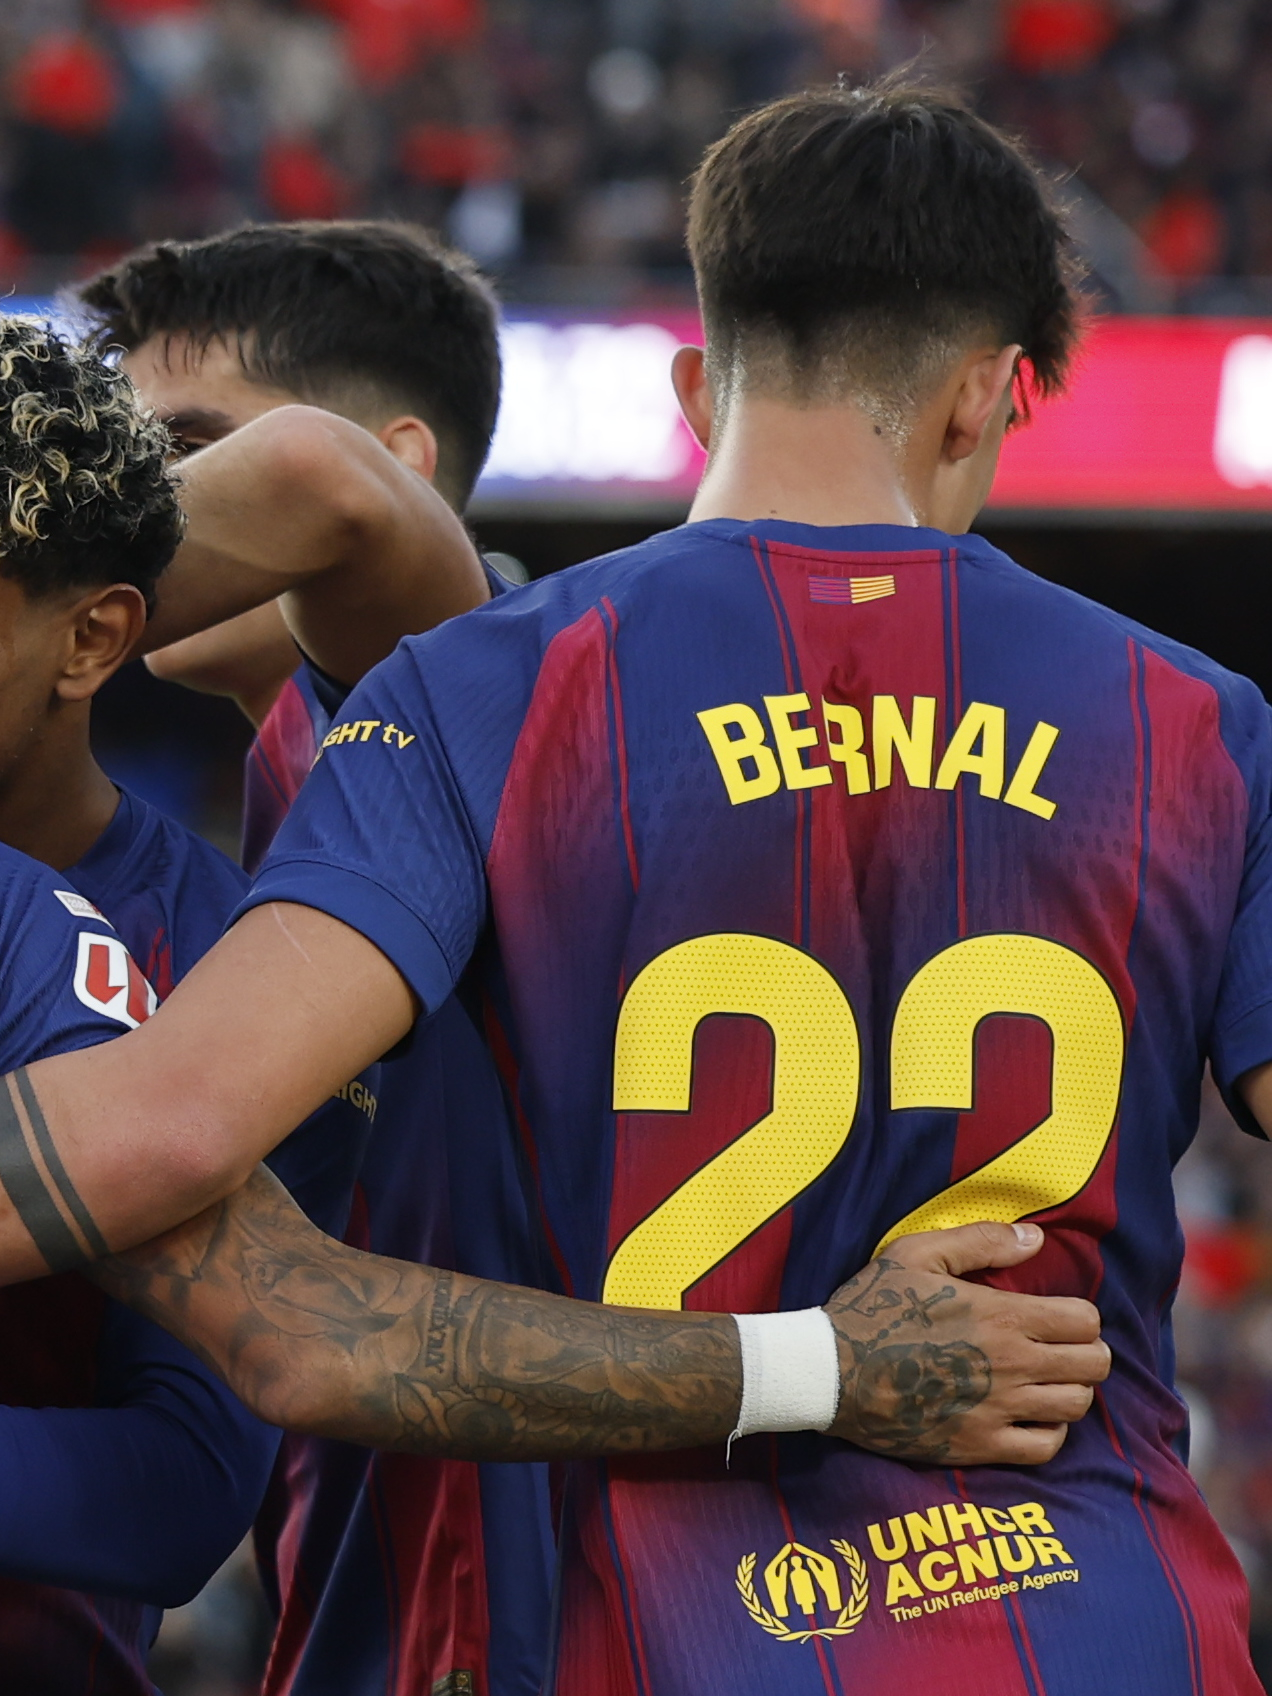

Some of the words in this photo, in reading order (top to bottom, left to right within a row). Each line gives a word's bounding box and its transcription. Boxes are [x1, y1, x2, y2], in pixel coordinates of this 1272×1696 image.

[383, 723, 416, 749] tv
[696, 692, 1061, 821] BERNAL
[602, 932, 1125, 1312] 22
[867, 1501, 1056, 1562] UNHCR
[885, 1535, 1075, 1606] ACNUR
[890, 1606, 923, 1623] The
[924, 1596, 951, 1614] UN
[951, 1579, 1021, 1607] Refugee
[1021, 1568, 1080, 1590] Agency
